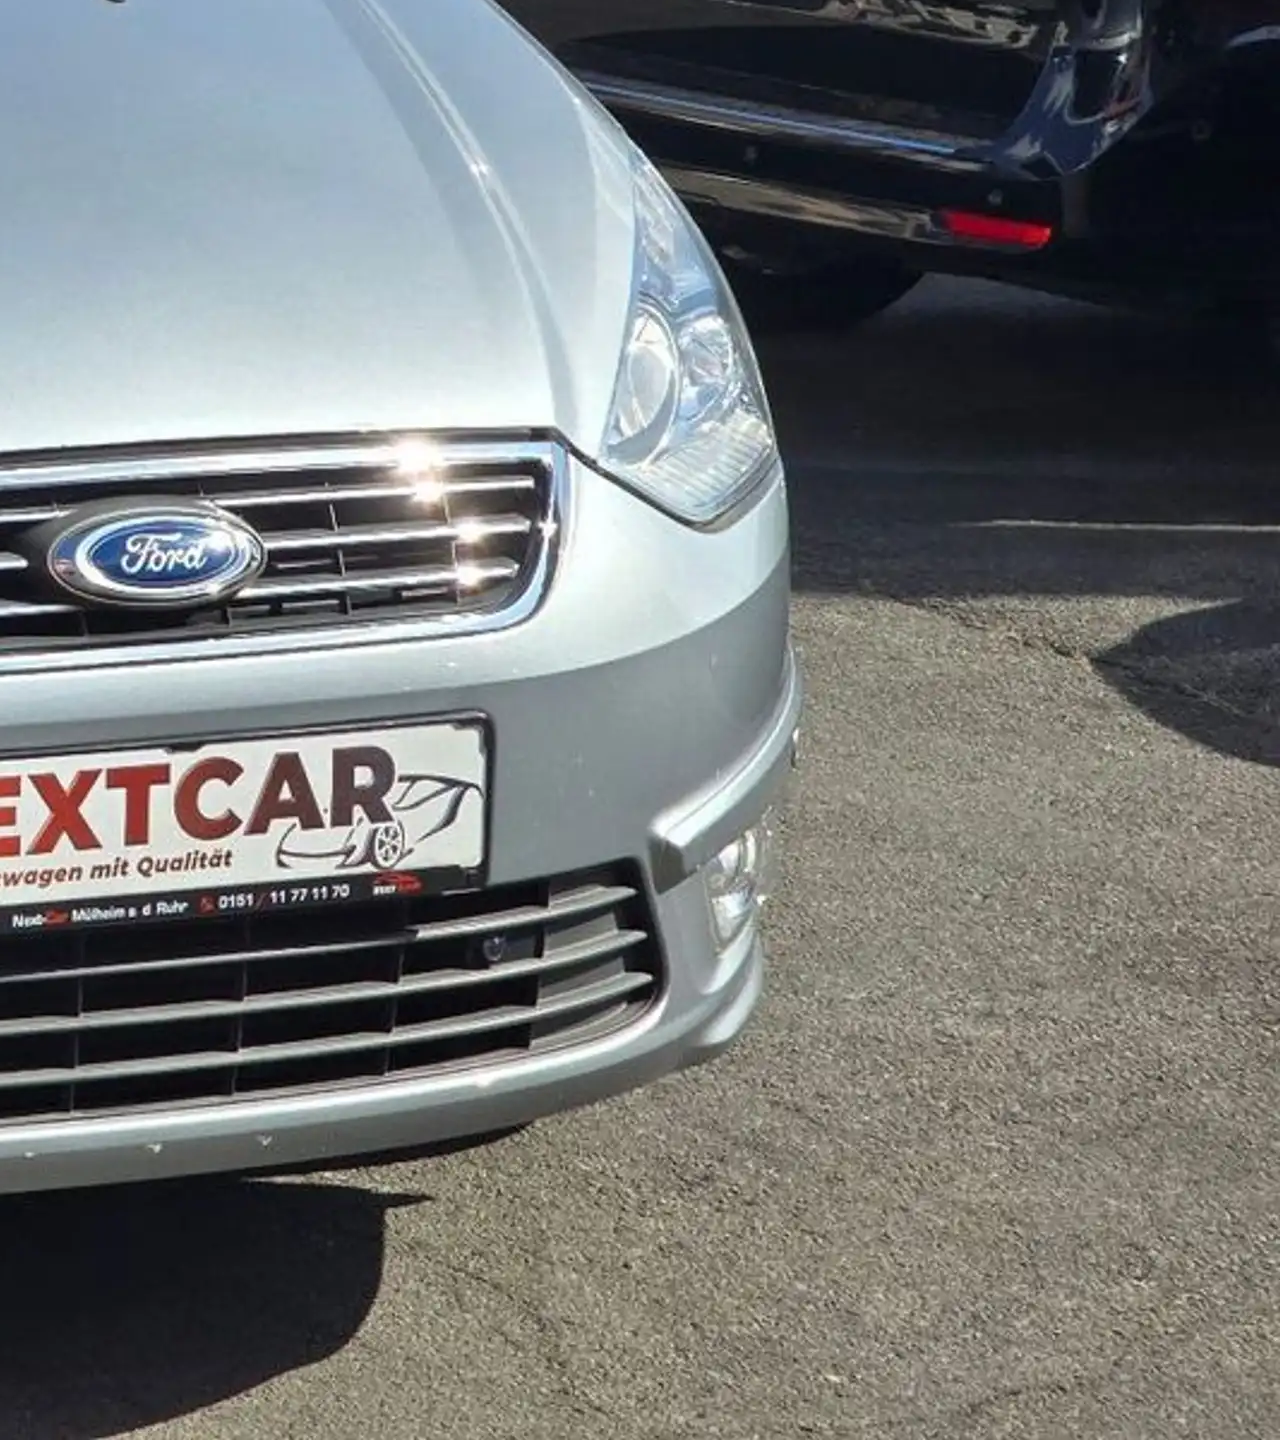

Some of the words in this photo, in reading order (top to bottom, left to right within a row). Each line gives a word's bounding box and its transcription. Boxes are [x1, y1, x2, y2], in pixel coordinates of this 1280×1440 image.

[120, 532, 207, 574] Ford
[89, 855, 130, 878] mit
[136, 849, 234, 878] Qualität
[270, 890, 286, 904] 11
[290, 888, 308, 901] 77
[311, 886, 328, 900] 11
[331, 884, 350, 898] 70
